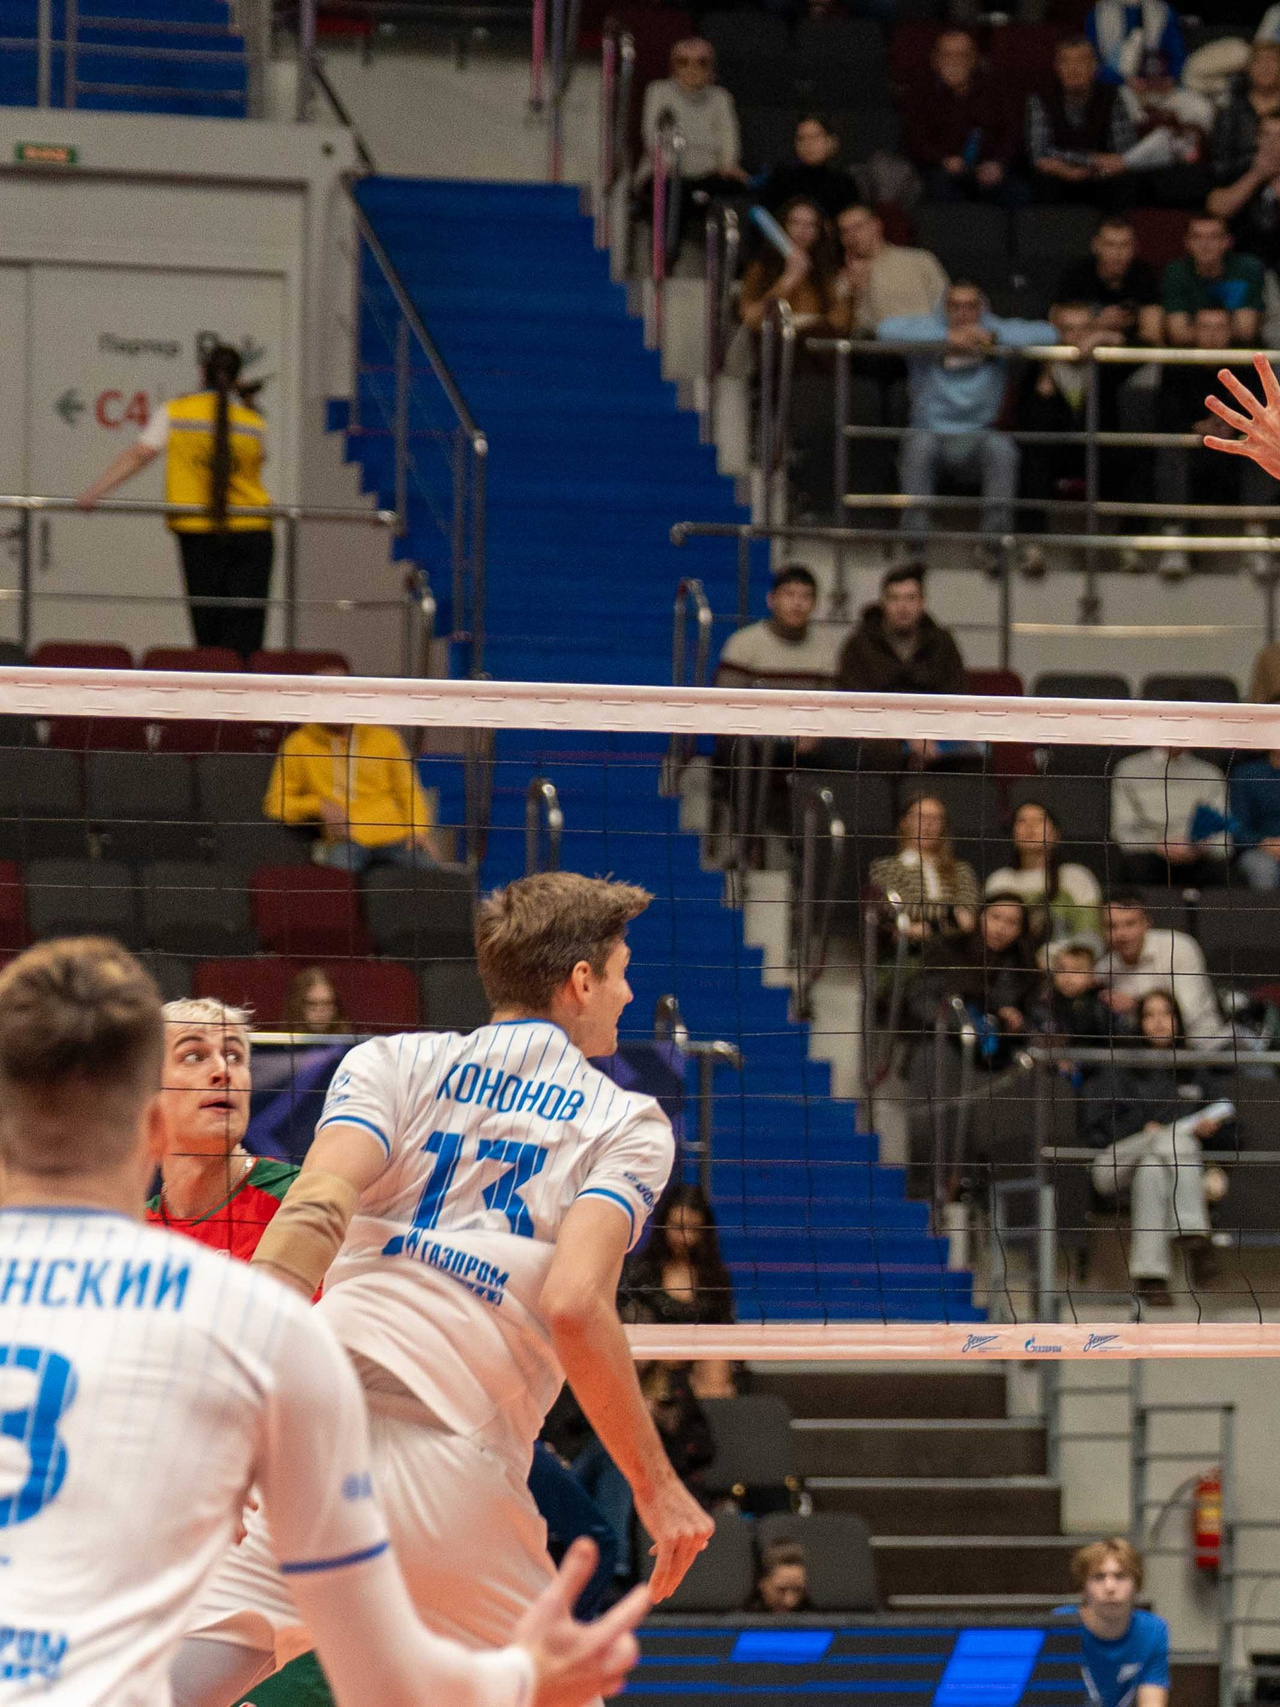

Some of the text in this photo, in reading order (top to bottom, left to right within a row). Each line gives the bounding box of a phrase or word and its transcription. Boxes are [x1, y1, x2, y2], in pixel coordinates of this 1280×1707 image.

[436, 1062, 585, 1122] КОНОНОВ
[411, 1131, 549, 1239] 13
[420, 1239, 510, 1289] ГАЗПРОМ
